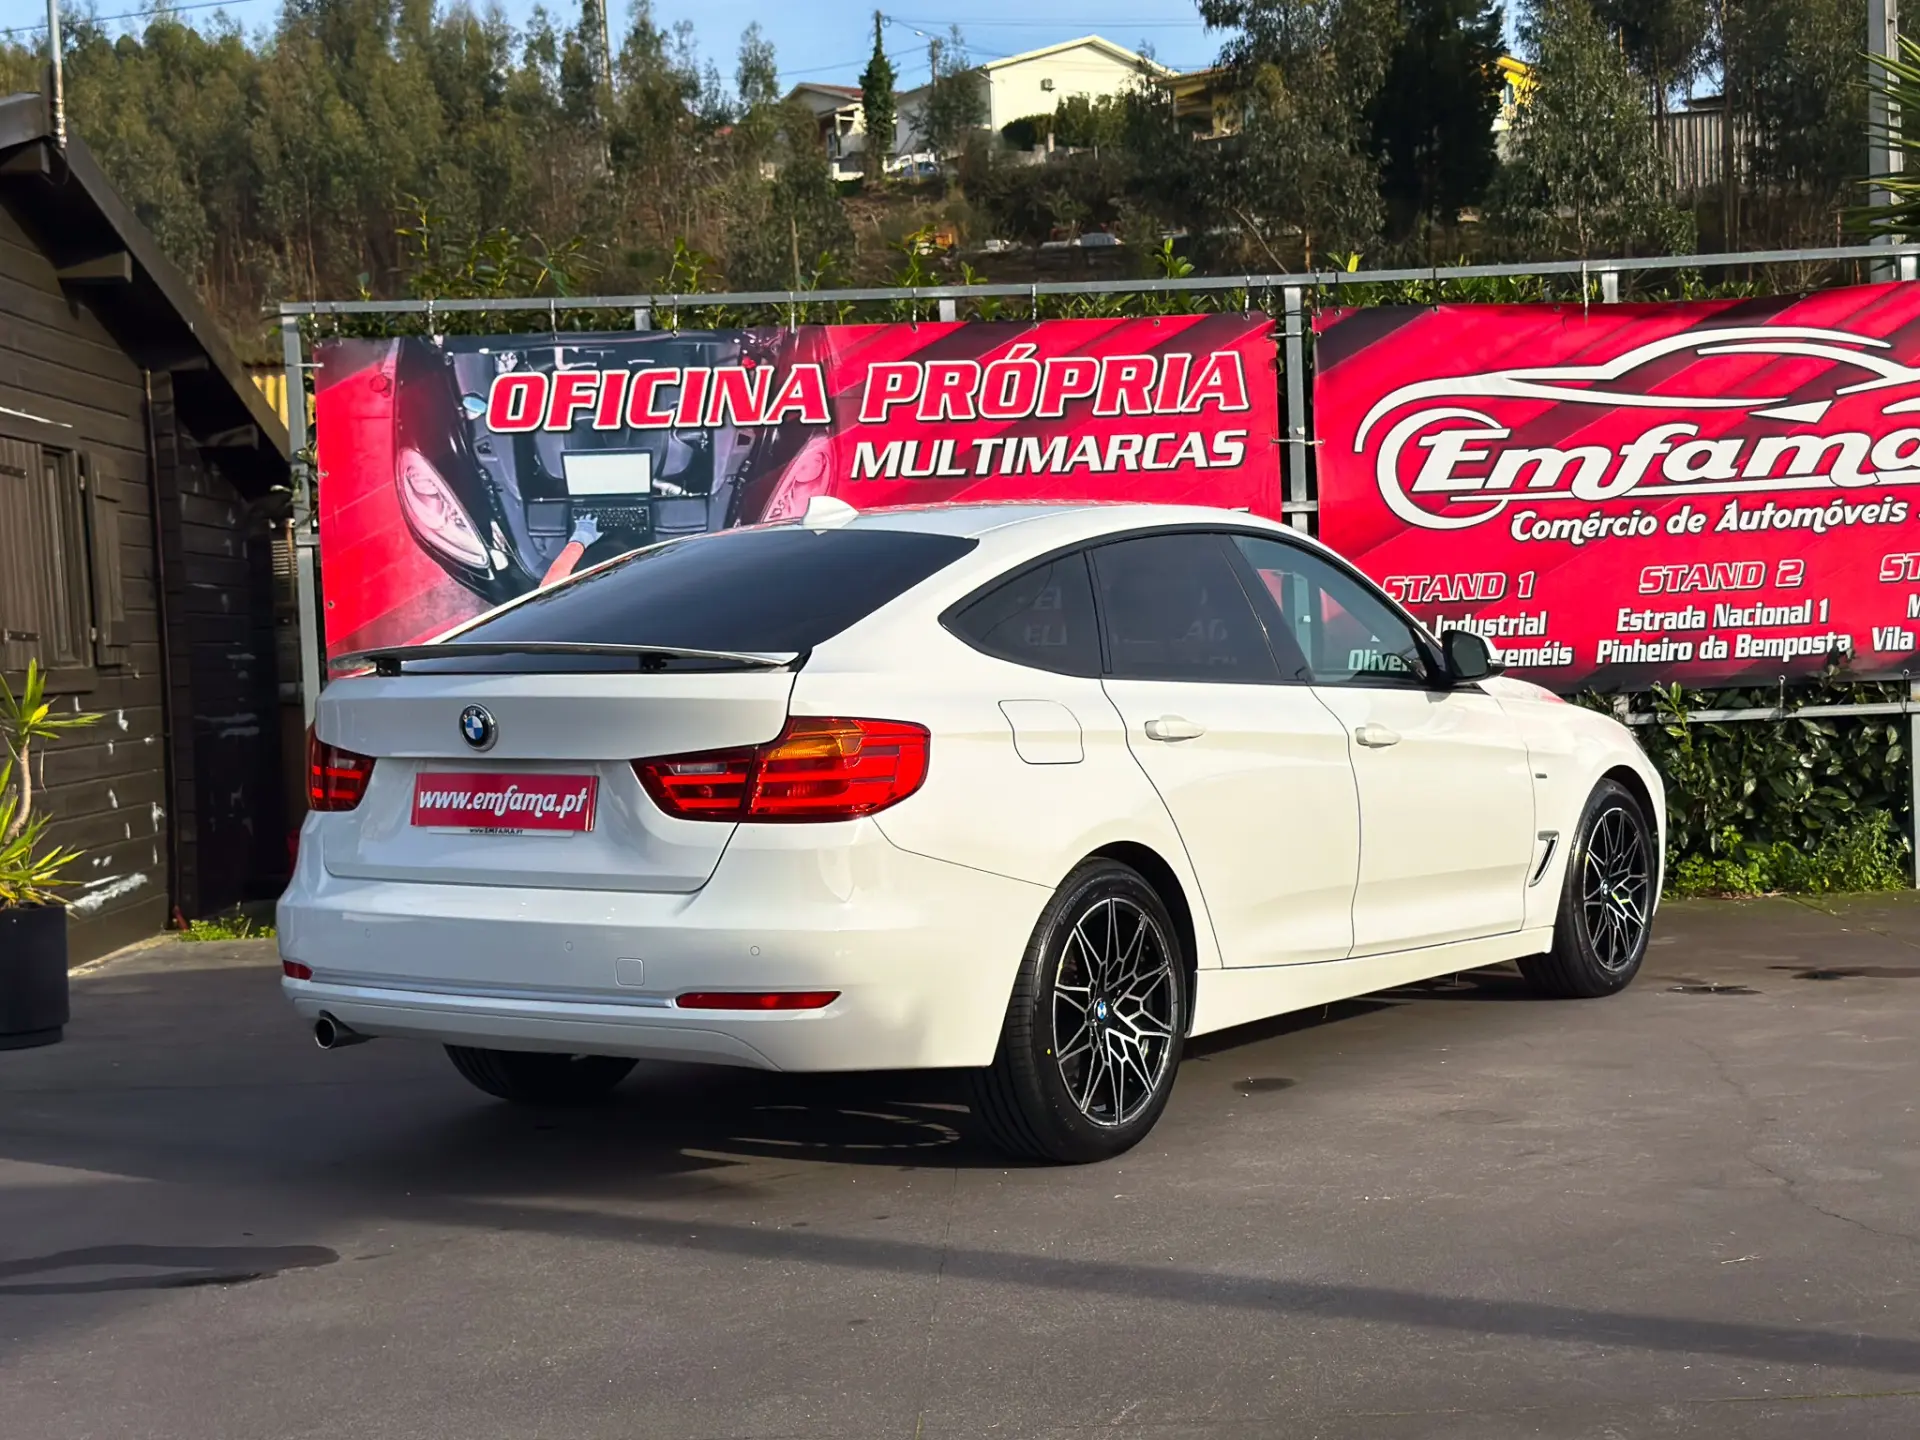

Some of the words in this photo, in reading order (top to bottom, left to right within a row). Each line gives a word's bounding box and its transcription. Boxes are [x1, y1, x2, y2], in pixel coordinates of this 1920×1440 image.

[486, 362, 831, 432] OFICINA
[859, 343, 1250, 423] PRÓPRIA
[850, 430, 1247, 478] MULTIMARCAS
[1411, 422, 1920, 501] Emfama
[1511, 509, 1658, 545] Comércio
[1666, 505, 1707, 534] de
[1714, 496, 1908, 533] Automóveis
[1383, 572, 1506, 602] STAND
[1518, 571, 1535, 598] 1
[1638, 560, 1766, 594] STAND
[1775, 559, 1805, 588] 2
[1434, 610, 1547, 638] Industrial
[1616, 605, 1706, 633] Estrada
[1712, 598, 1811, 628] Nacional
[1818, 598, 1831, 623] 1
[1595, 637, 1693, 664] Pinheiro
[1699, 635, 1725, 659] da
[1734, 631, 1851, 662] Bemposta
[1872, 626, 1914, 651] Vila
[1347, 648, 1411, 672] Olive
[419, 785, 588, 818] www.emfama.pt
